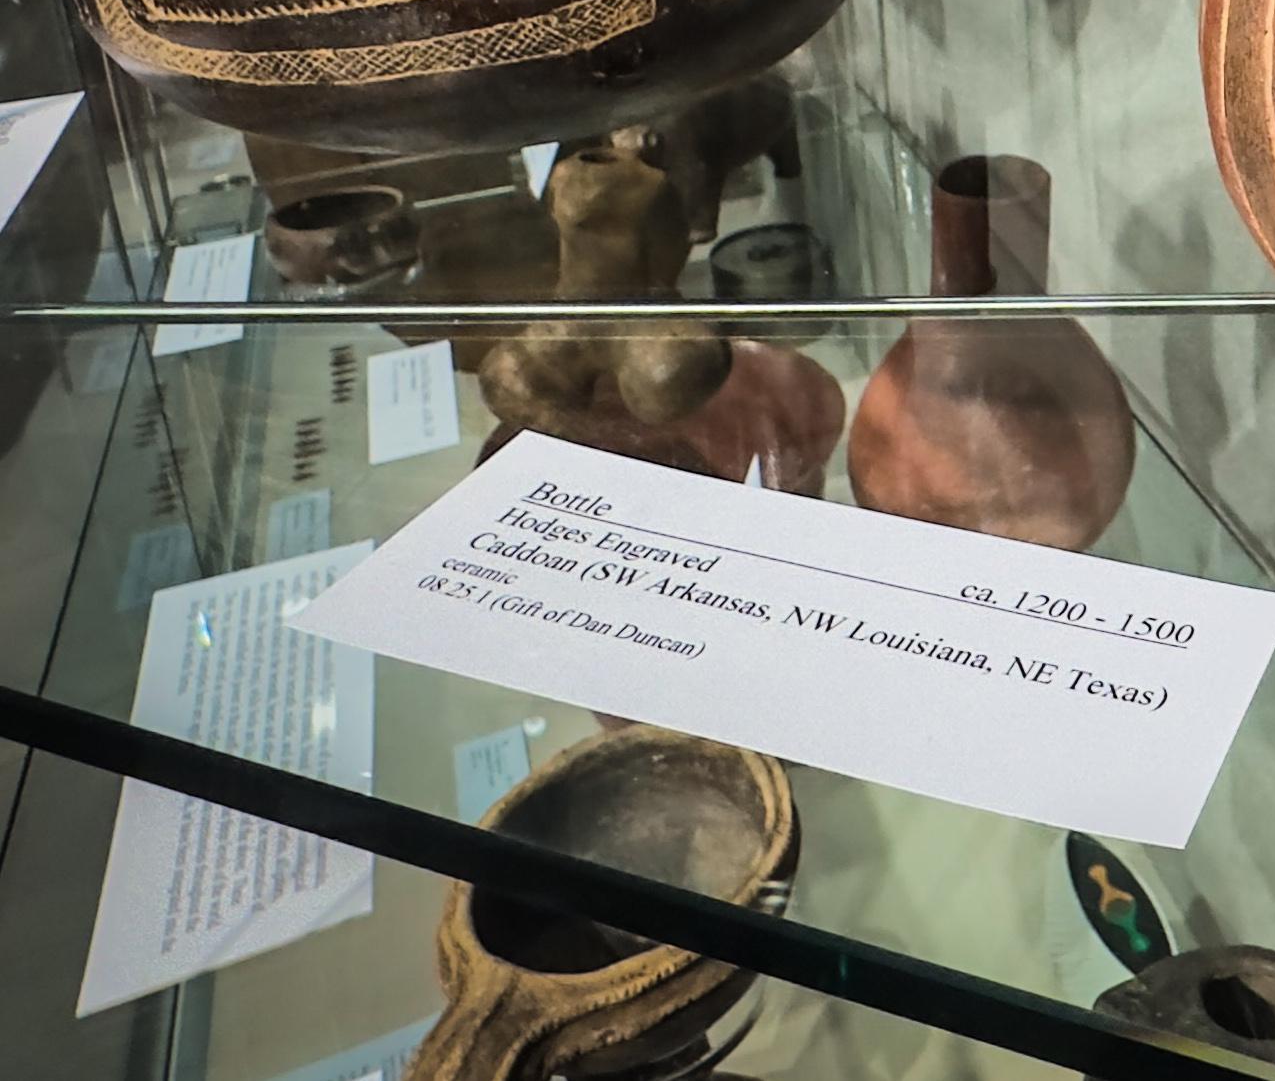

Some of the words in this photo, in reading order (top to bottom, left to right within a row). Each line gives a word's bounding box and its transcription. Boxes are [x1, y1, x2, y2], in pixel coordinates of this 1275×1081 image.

[441, 558, 520, 585] ceramic
[497, 507, 593, 545] Hodges
[594, 531, 722, 573] Engraved
[528, 481, 613, 516] Bottle
[960, 584, 998, 605] ca.
[1014, 591, 1087, 622] 1200
[1120, 613, 1196, 644] 1500
[417, 574, 493, 605] 08.25.1
[488, 595, 544, 619] (Gift
[542, 609, 572, 624] of
[567, 612, 614, 636] Dan
[613, 623, 707, 659] Duncan)
[468, 532, 579, 573] Caddoan
[579, 560, 649, 587] (SW
[645, 577, 772, 622] Arkansas,
[781, 605, 849, 633] NW
[847, 620, 993, 675] Louisiana,
[1004, 655, 1060, 685] NE
[1067, 668, 1169, 711] Texas)
